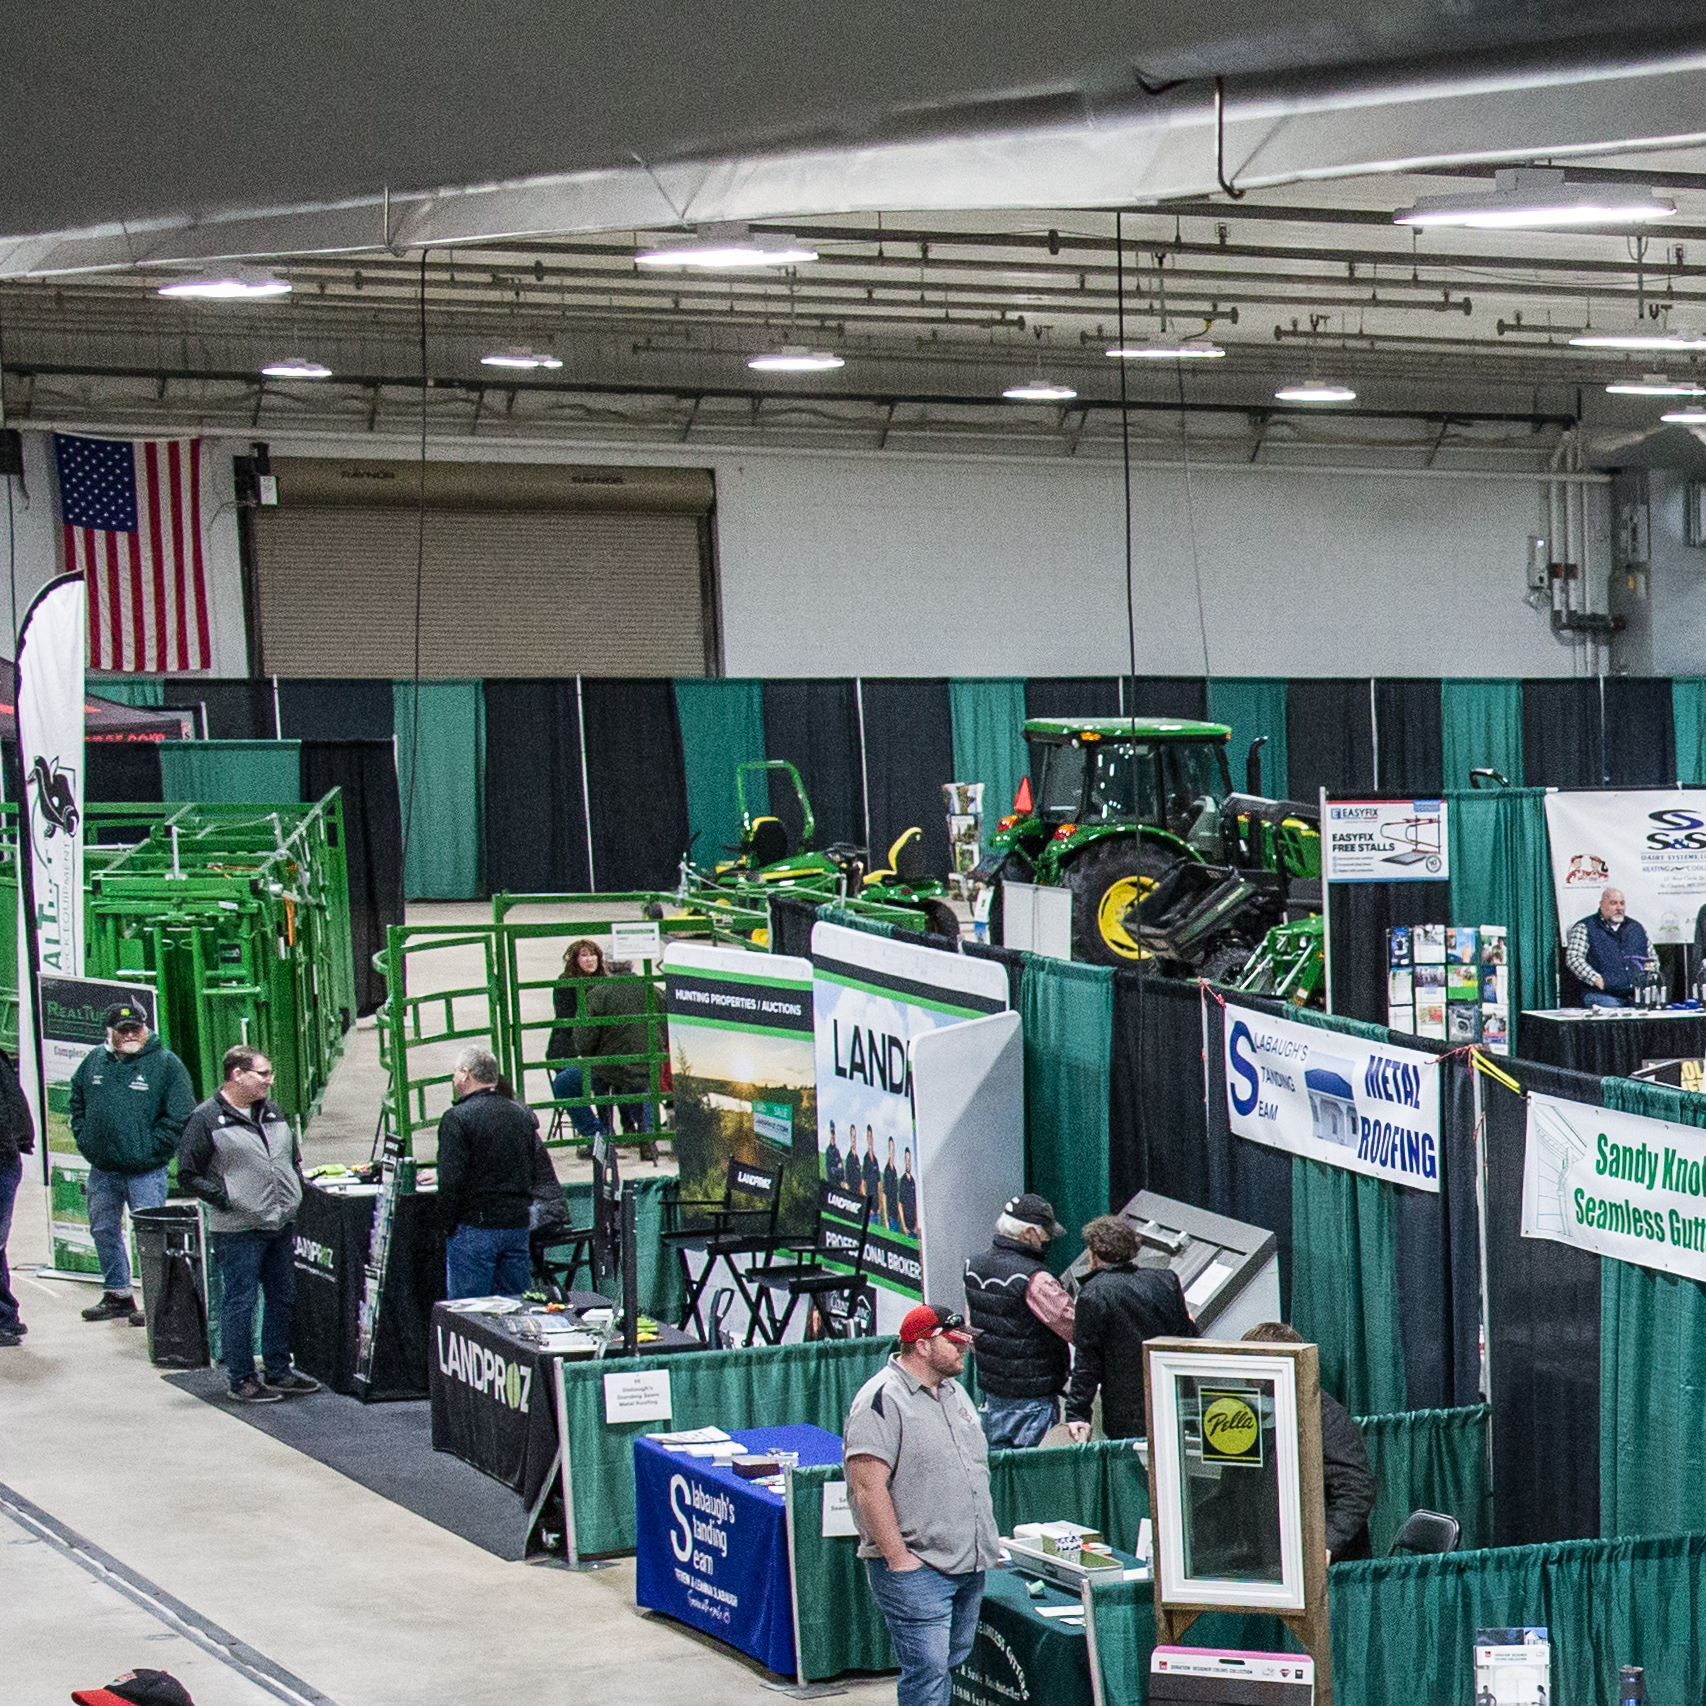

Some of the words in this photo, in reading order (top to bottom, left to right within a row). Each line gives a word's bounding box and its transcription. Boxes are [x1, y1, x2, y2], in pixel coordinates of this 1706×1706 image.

[1342, 808, 1378, 818] EASYFIX
[1332, 833, 1374, 843] EASYFIX
[1332, 843, 1356, 852] FREE
[1358, 842, 1395, 852] STALLS
[676, 988, 710, 1006] HUNTING
[711, 992, 757, 1012] PROPERTIES
[761, 997, 801, 1016] AUCTIONS
[1365, 1054, 1421, 1110] METAL
[1357, 1116, 1437, 1179] ROOFING
[1595, 1133, 1658, 1191] Sandy
[1573, 1187, 1665, 1243] Seamless
[436, 1325, 532, 1413] LANDPROZ
[1207, 1409, 1256, 1437] Pella
